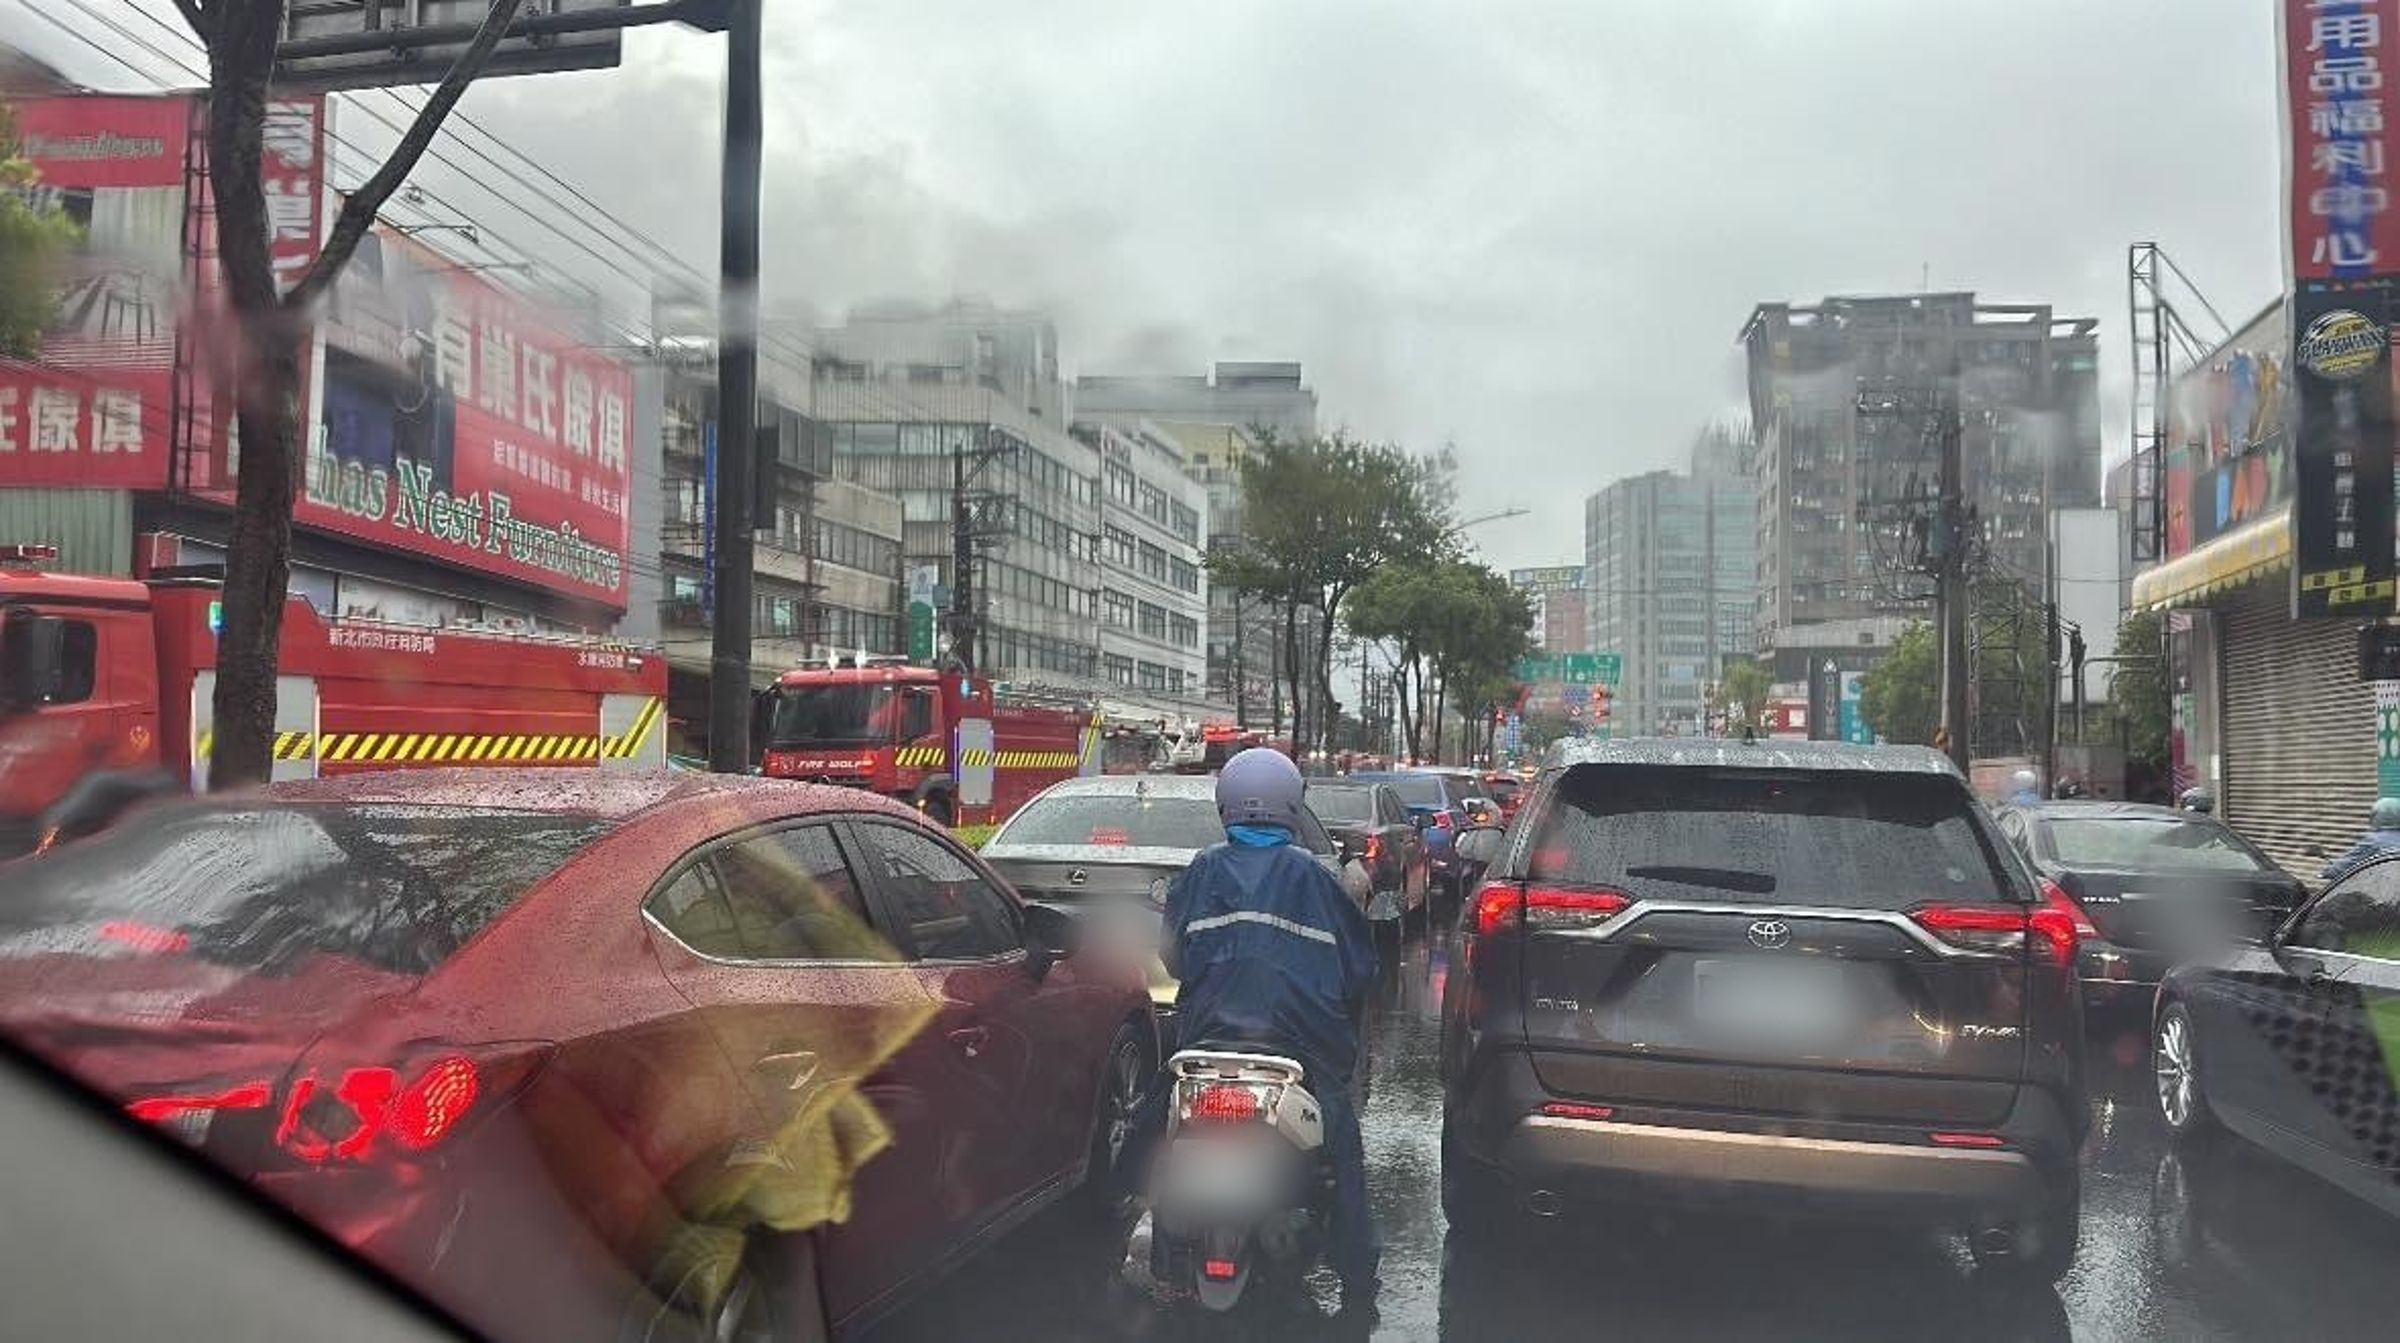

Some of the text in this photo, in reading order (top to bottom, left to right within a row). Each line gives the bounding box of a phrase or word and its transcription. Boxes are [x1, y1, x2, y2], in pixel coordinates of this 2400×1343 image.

[2306, 0, 2386, 266] 用品福利中心
[393, 457, 483, 548] Nest
[485, 490, 619, 590] Furniture
[798, 759, 824, 769] FIRE
